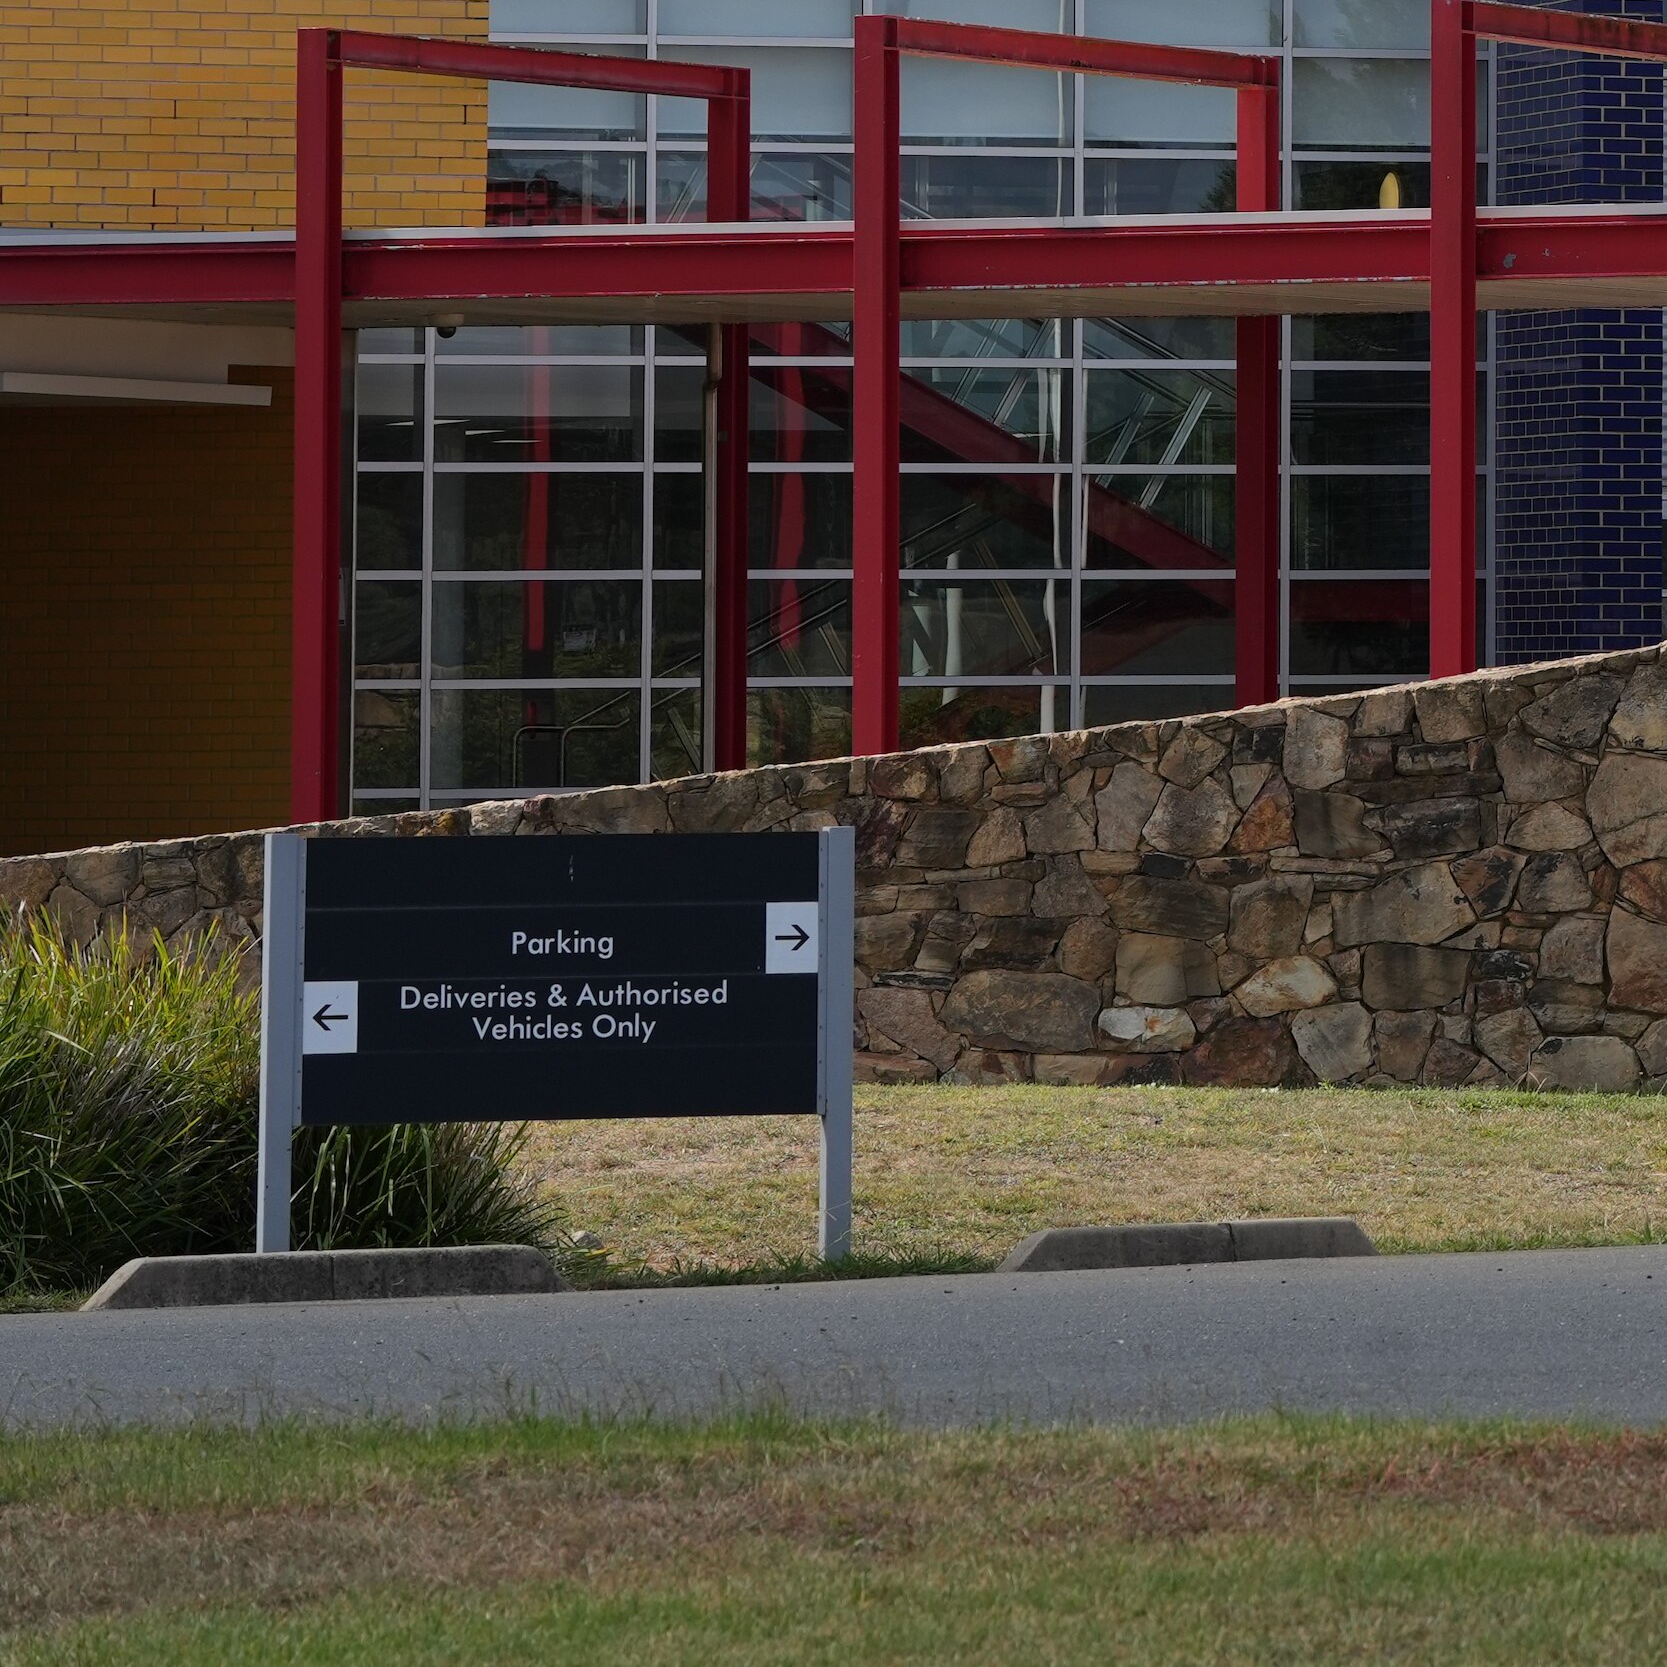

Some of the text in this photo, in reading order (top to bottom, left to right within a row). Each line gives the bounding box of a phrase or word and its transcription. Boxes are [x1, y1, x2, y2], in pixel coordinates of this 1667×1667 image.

[511, 929, 615, 959] Parking
[400, 979, 728, 1010] Deliveries & Authorised
[472, 1012, 657, 1043] Vehicles Only
